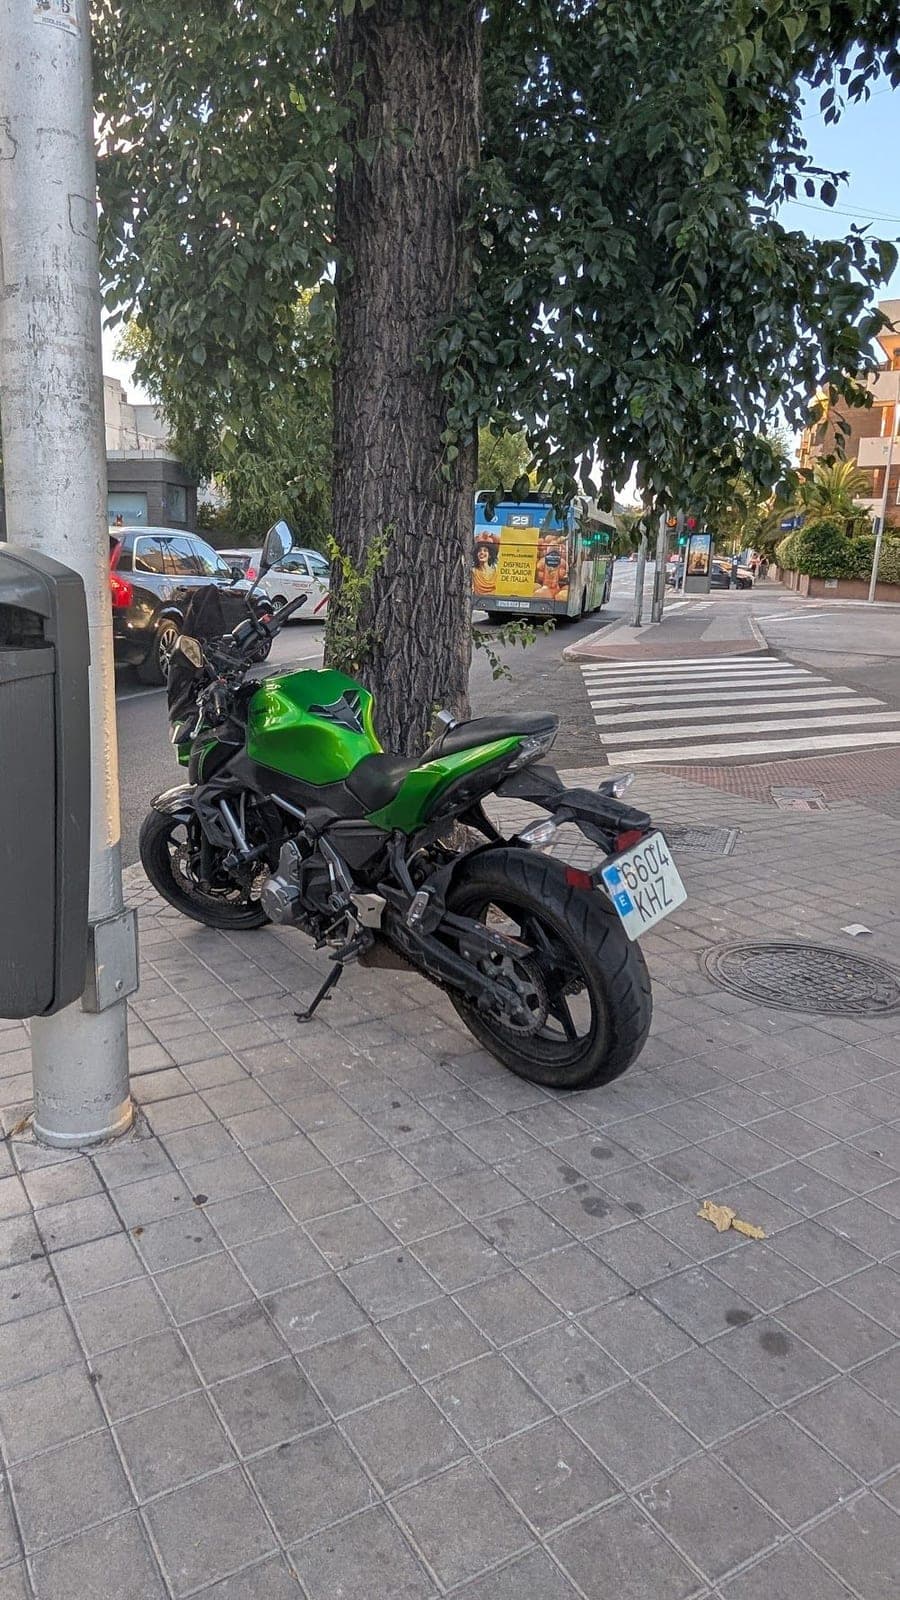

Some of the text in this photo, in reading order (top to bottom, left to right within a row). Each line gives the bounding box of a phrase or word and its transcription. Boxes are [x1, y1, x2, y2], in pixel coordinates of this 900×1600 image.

[512, 516, 529, 525] 29
[621, 840, 669, 890] 6604
[618, 895, 627, 907] E
[633, 876, 673, 922] KHZ
